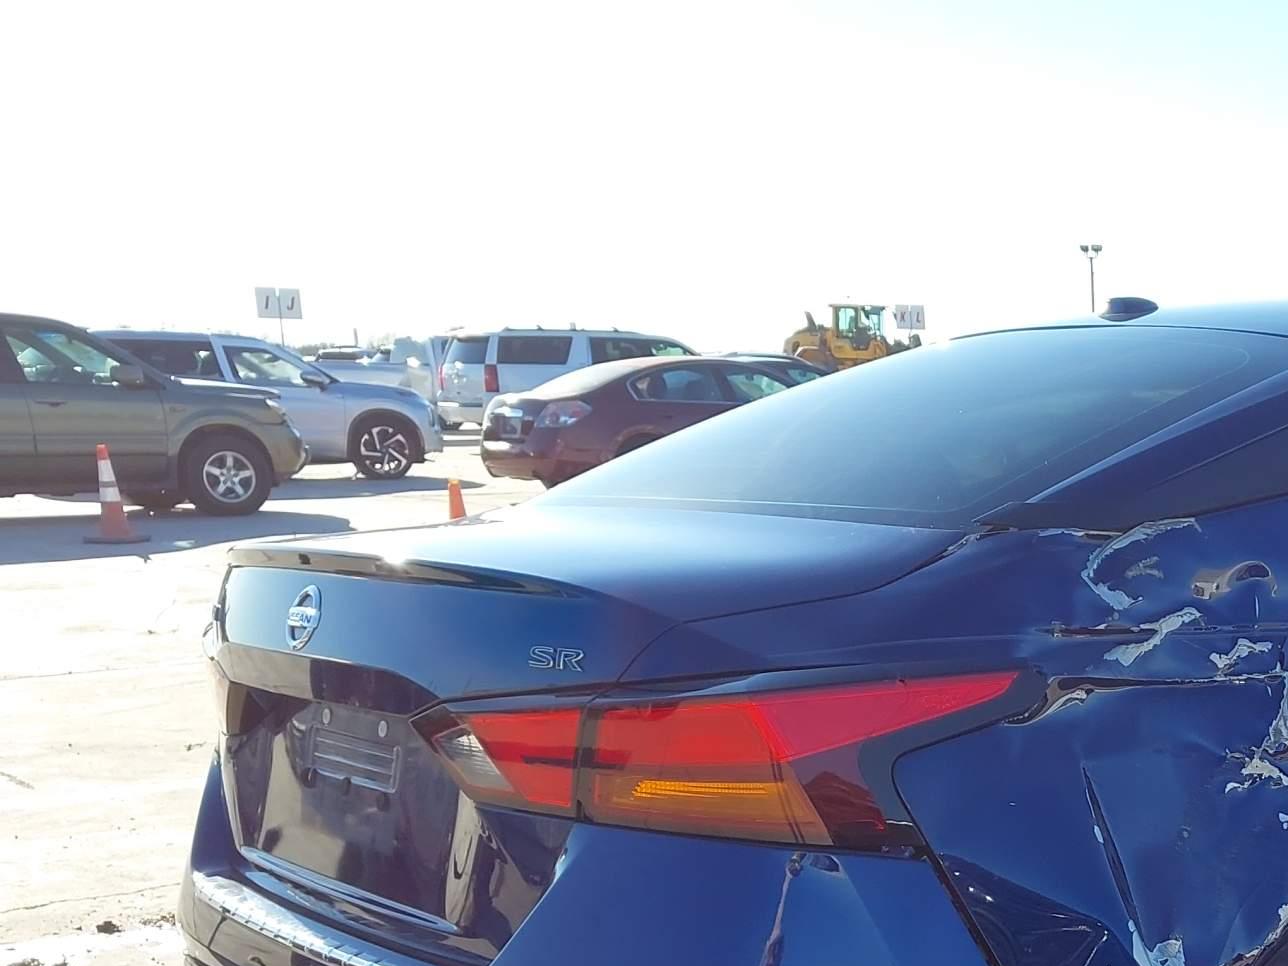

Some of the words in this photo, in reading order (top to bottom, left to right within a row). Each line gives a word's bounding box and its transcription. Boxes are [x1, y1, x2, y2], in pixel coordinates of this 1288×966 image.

[265, 295, 270, 310] I
[286, 296, 295, 311] J
[899, 311, 906, 322] K
[916, 311, 921, 323] L
[528, 645, 584, 672] SR
